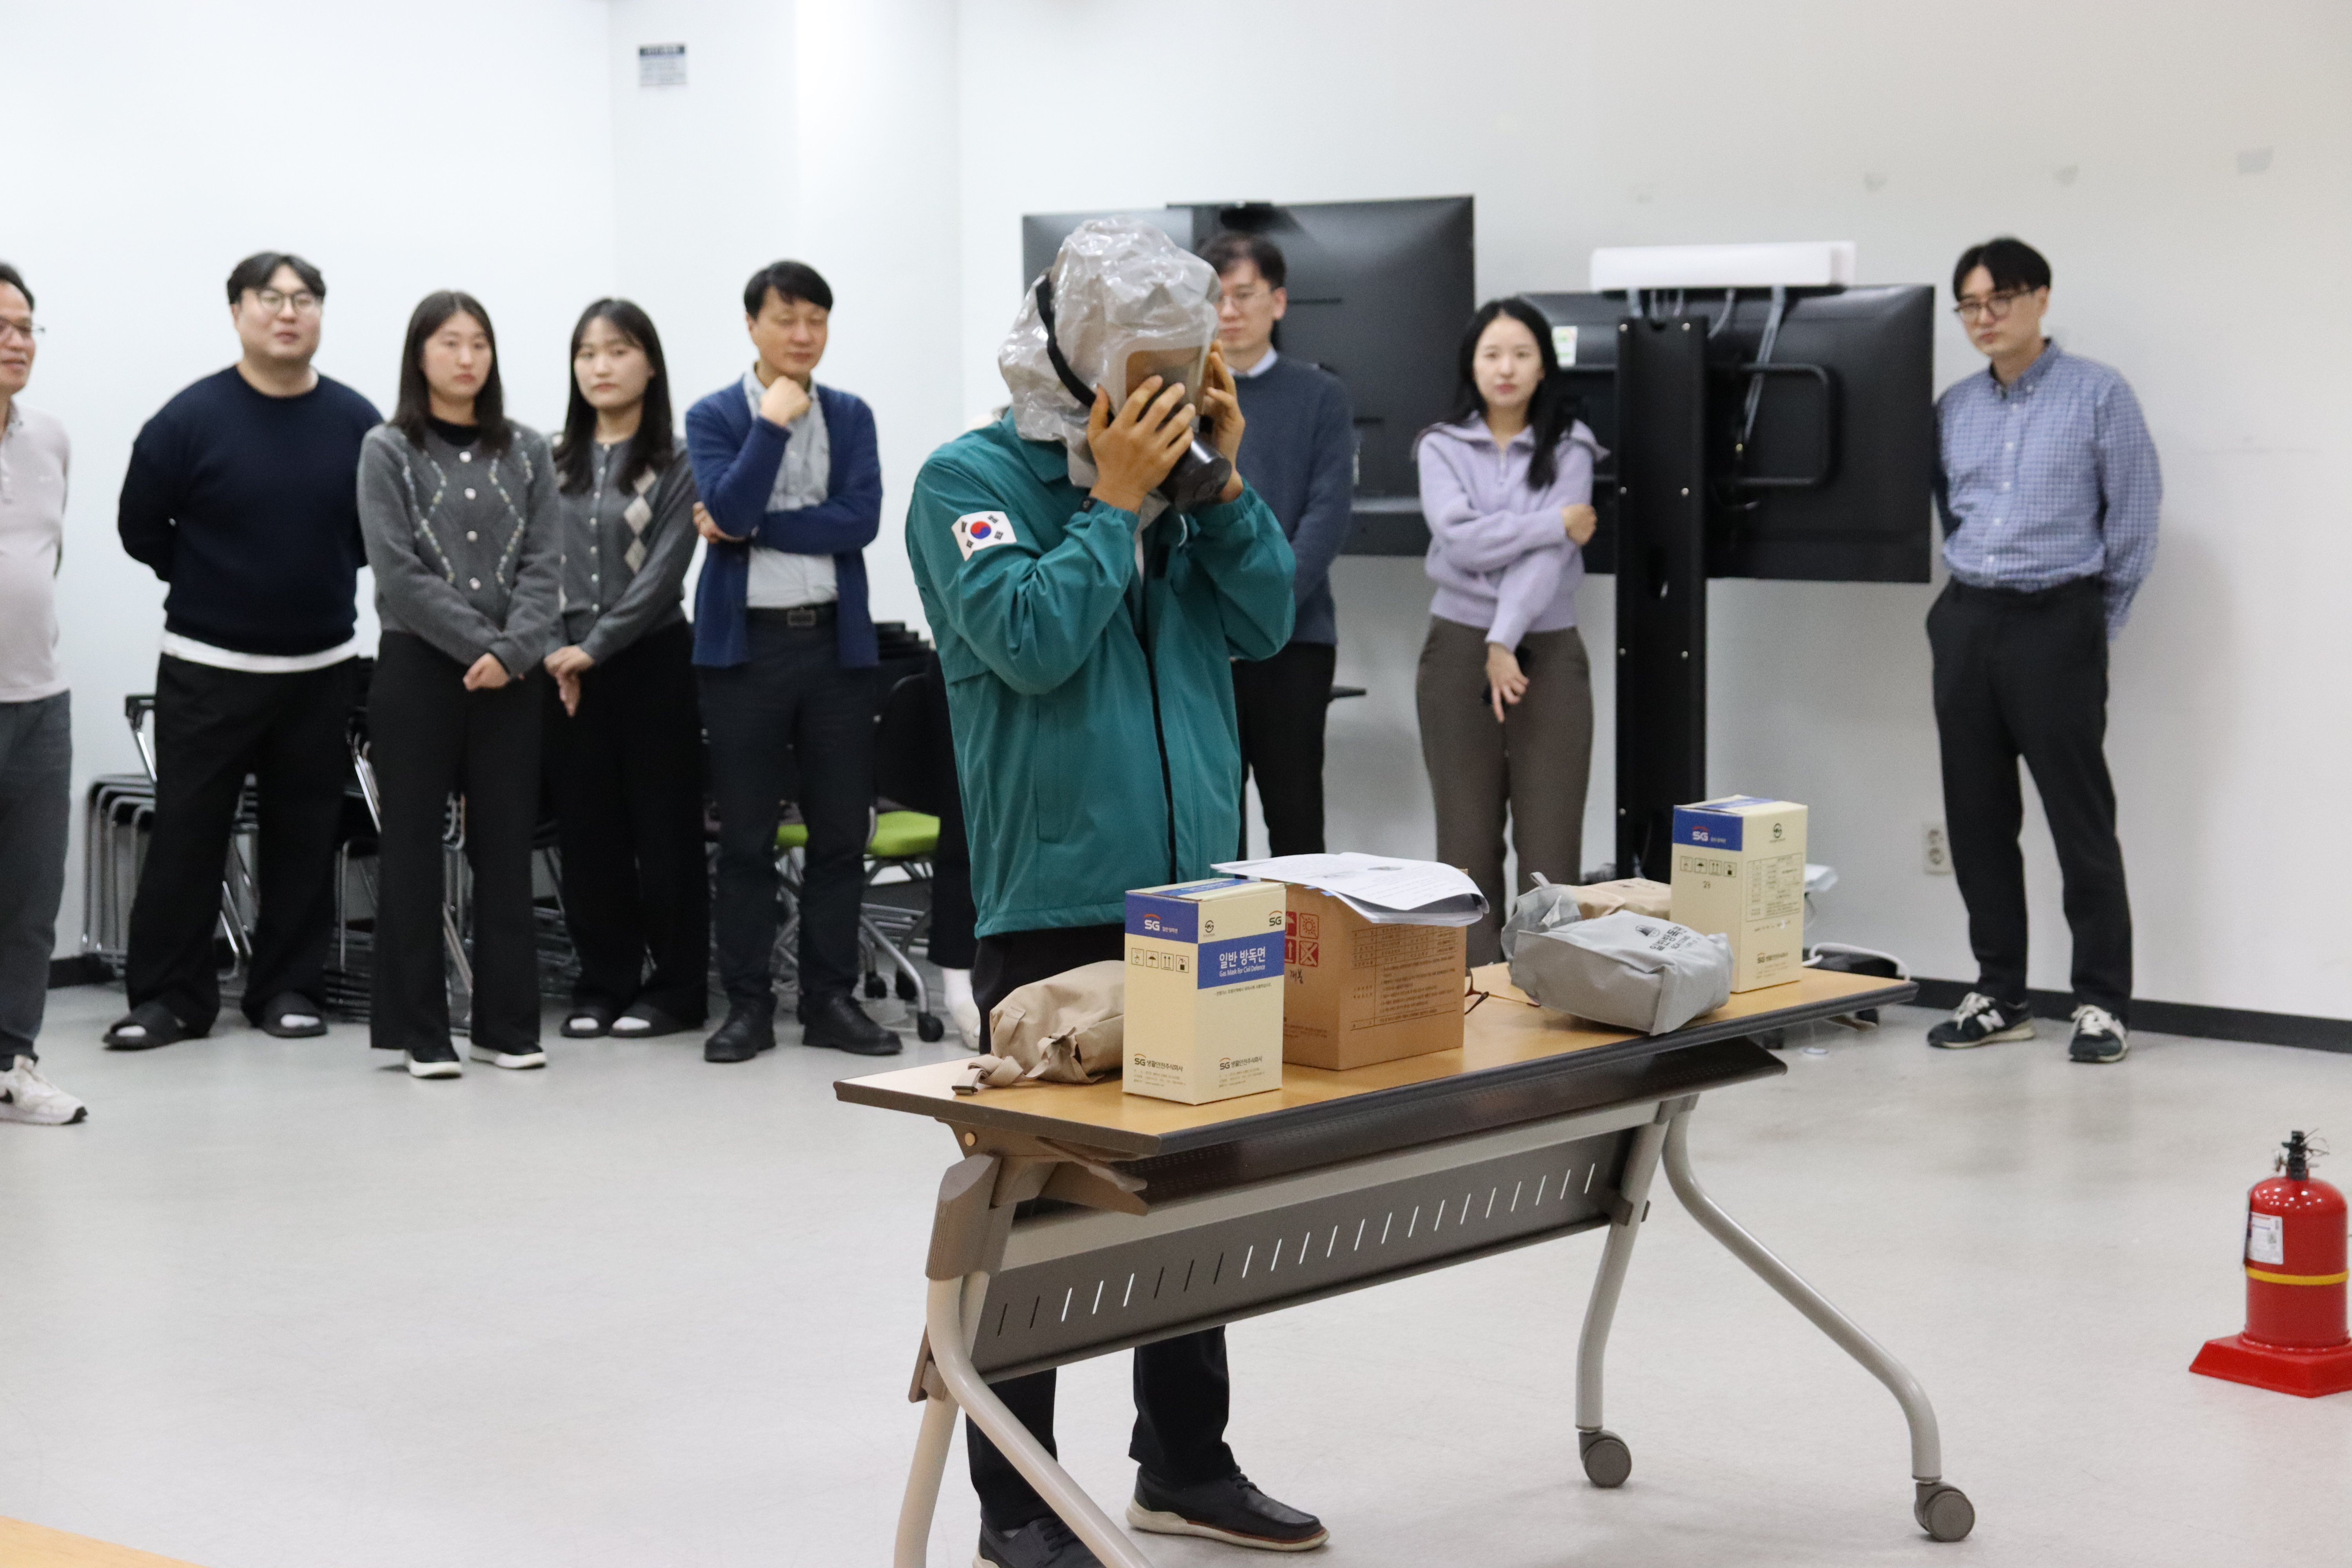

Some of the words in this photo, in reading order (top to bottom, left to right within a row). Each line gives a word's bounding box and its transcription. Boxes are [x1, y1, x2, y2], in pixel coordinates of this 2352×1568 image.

[1692, 831, 1708, 842] SG
[1144, 919, 1160, 931] SG
[1269, 916, 1282, 926] SG
[1219, 951, 1238, 969] 일반
[1240, 946, 1265, 965] 방독면
[1134, 1058, 1145, 1066] SG
[1147, 1060, 1183, 1072] 생활안전주식회사
[1220, 1062, 1230, 1070] SG
[1231, 1056, 1262, 1068] 생활안전주식회사
